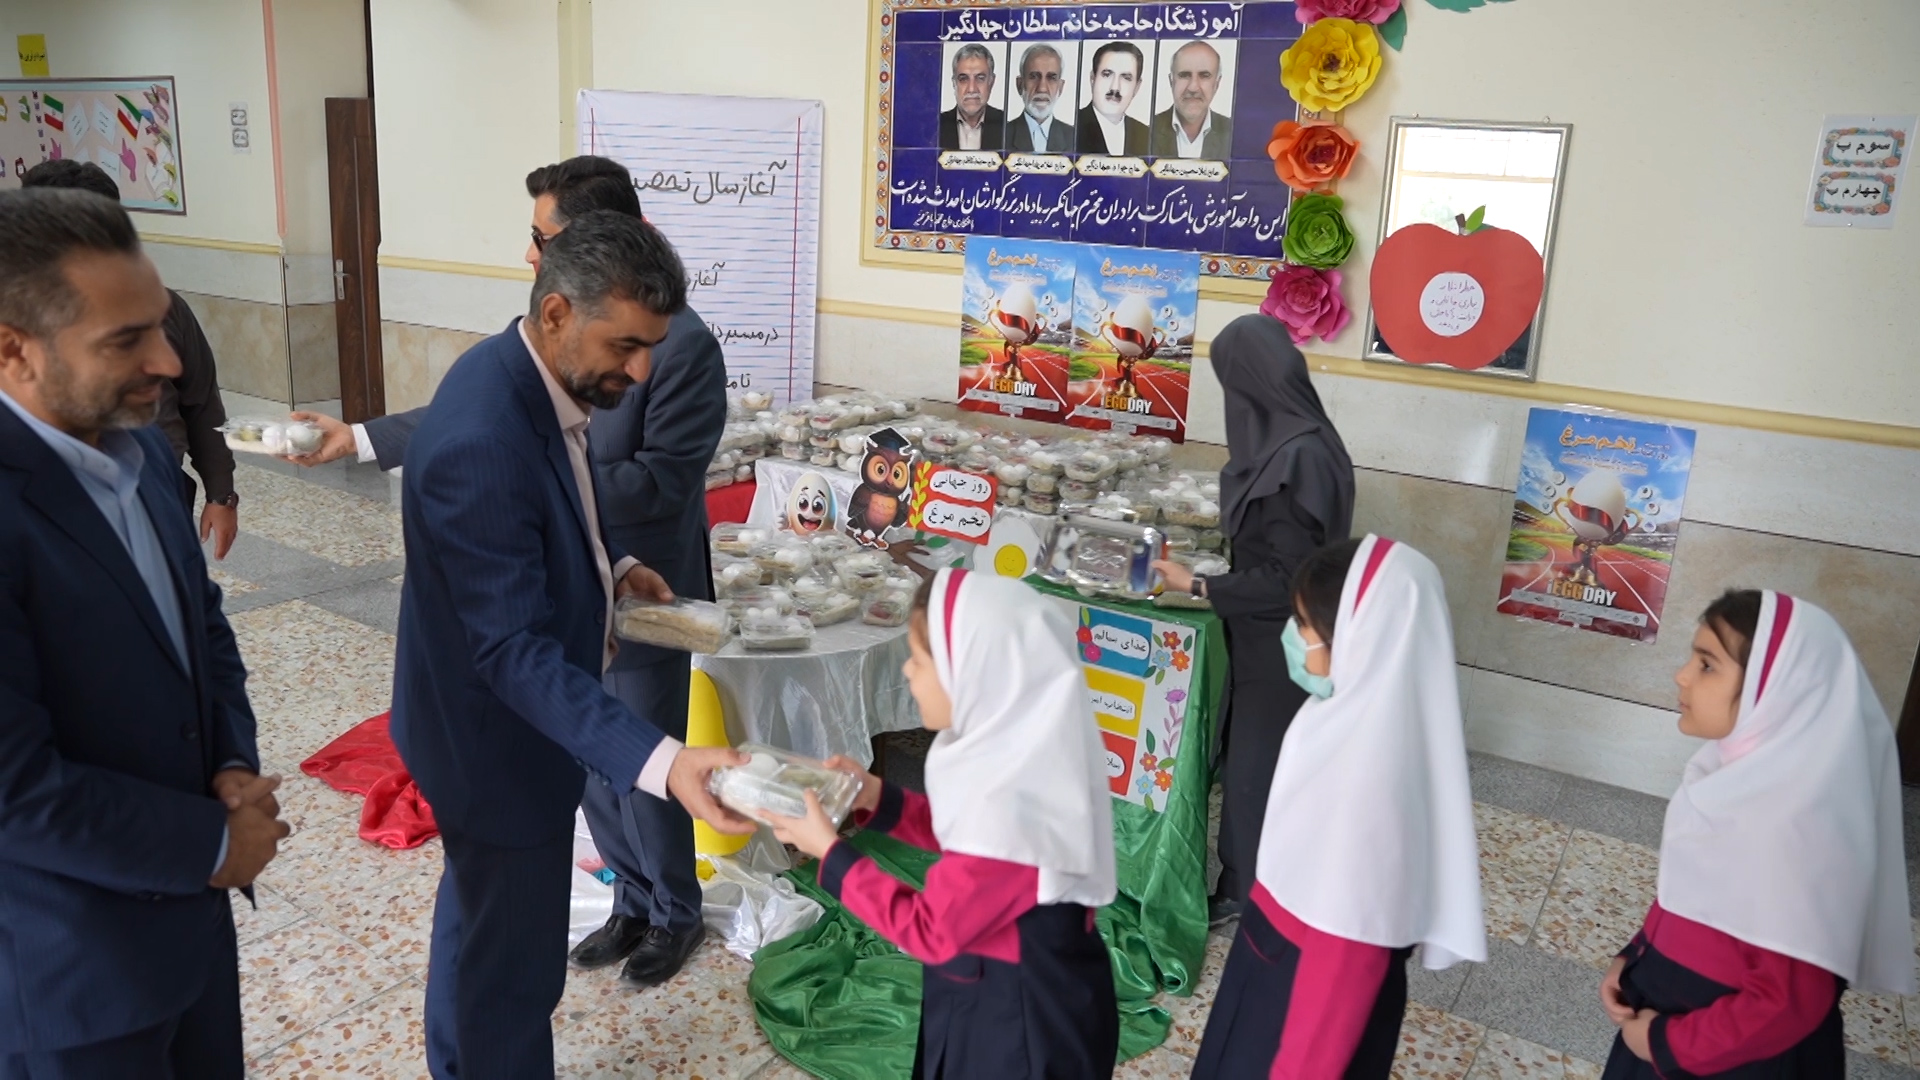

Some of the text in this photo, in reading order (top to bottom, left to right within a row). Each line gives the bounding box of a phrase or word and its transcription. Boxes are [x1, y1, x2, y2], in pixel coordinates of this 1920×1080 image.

[938, 2, 1246, 40] آموزشگاه حاجیه خانم سلطان جهانگیر
[1836, 142, 1891, 155] سوم ب
[633, 159, 787, 206] آغاز سال تحصی
[891, 179, 918, 206] است
[906, 179, 928, 206] شده
[1842, 184, 1881, 199] چهارم
[926, 184, 965, 208] احداث
[961, 174, 1022, 224] بزرگوارشان
[1012, 191, 1030, 215] مادر
[1045, 177, 1082, 228] جهانگیر
[1137, 185, 1188, 225] مشارکت
[1076, 189, 1104, 231] محترم
[1096, 198, 1140, 233] برادران
[1192, 189, 1247, 234] آموزشی
[1229, 205, 1259, 228] واحد
[1255, 207, 1287, 241] این
[691, 261, 726, 292] آغاز
[723, 329, 764, 346] مسیر
[764, 327, 779, 346] در
[740, 373, 751, 388] تا
[933, 474, 989, 494] روز جهانی
[928, 503, 987, 528] تخم مرغ
[1094, 630, 1147, 653] غذای سالم
[1106, 757, 1121, 770] سلا
